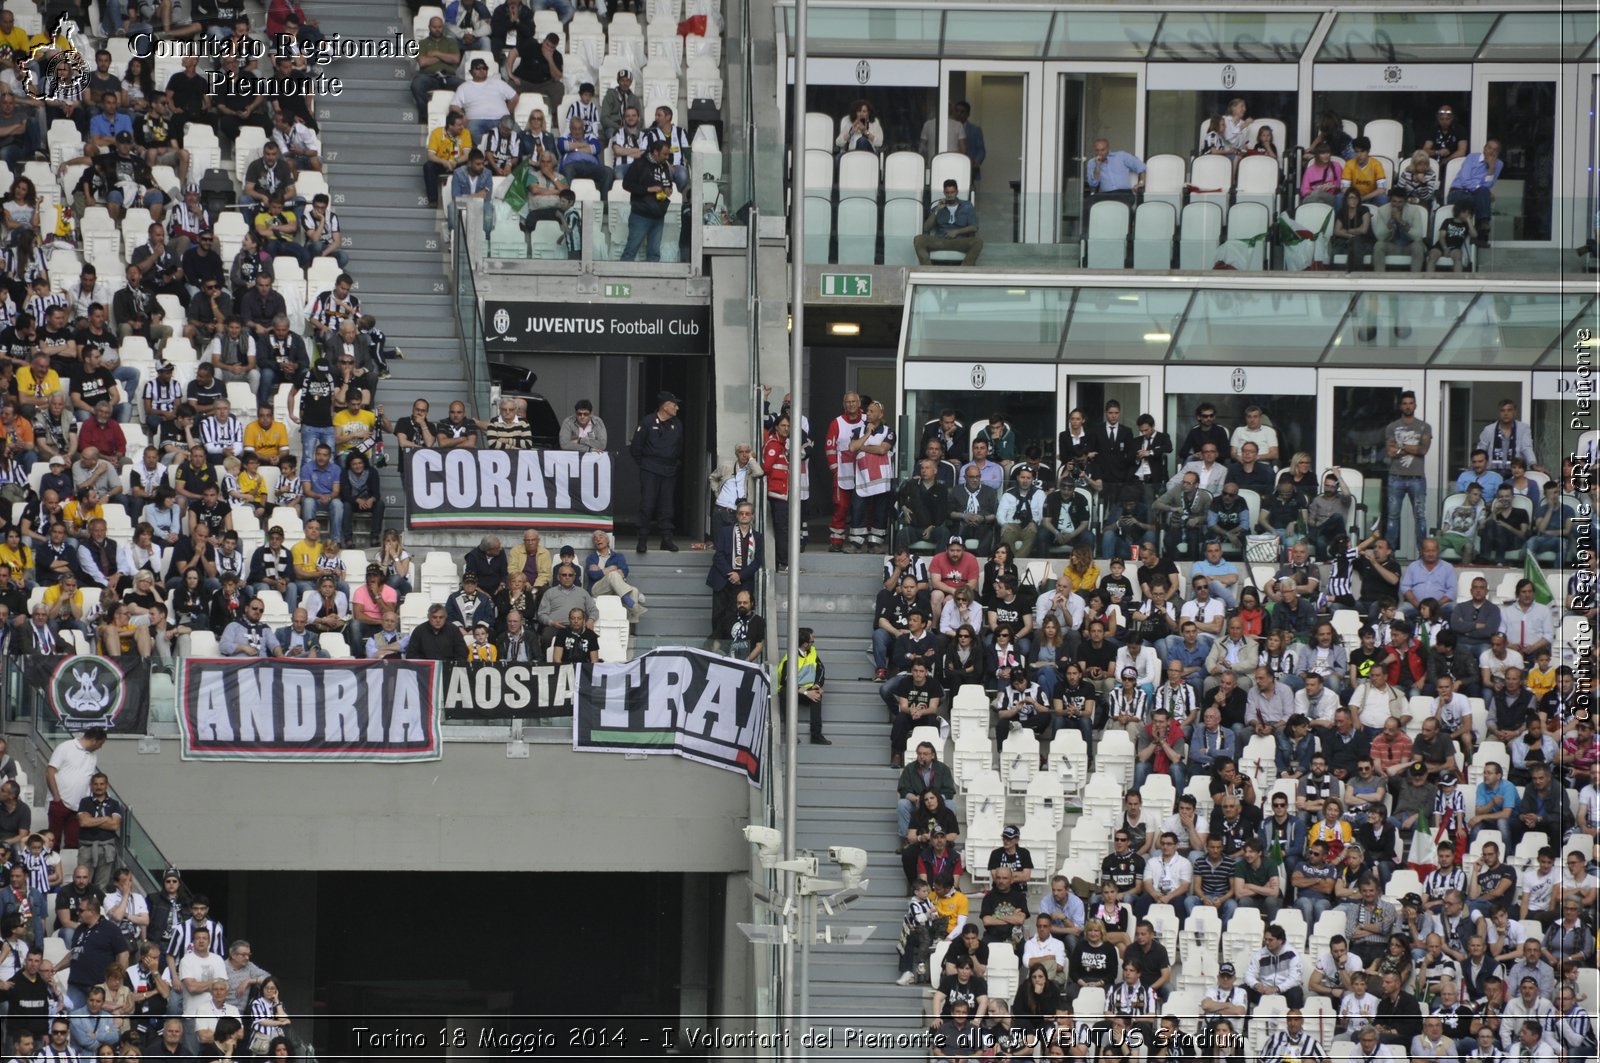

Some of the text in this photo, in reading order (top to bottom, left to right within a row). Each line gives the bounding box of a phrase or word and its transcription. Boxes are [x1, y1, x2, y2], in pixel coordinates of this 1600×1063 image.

[395, 69, 405, 78] 29
[319, 110, 330, 119] 28
[402, 112, 413, 121] 28
[326, 151, 338, 161] 27
[410, 154, 421, 163] 27
[334, 194, 345, 203] 26
[417, 196, 429, 206] 26
[341, 237, 352, 247] 25
[425, 240, 437, 249] 25
[433, 283, 444, 292] 24
[525, 317, 605, 334] JUVENTUS
[610, 319, 664, 335] Football
[668, 319, 700, 336] Club
[412, 448, 611, 512] CORATO
[385, 495, 396, 505] 19
[445, 664, 574, 709] AOSTA
[197, 667, 425, 743] ANDRIA
